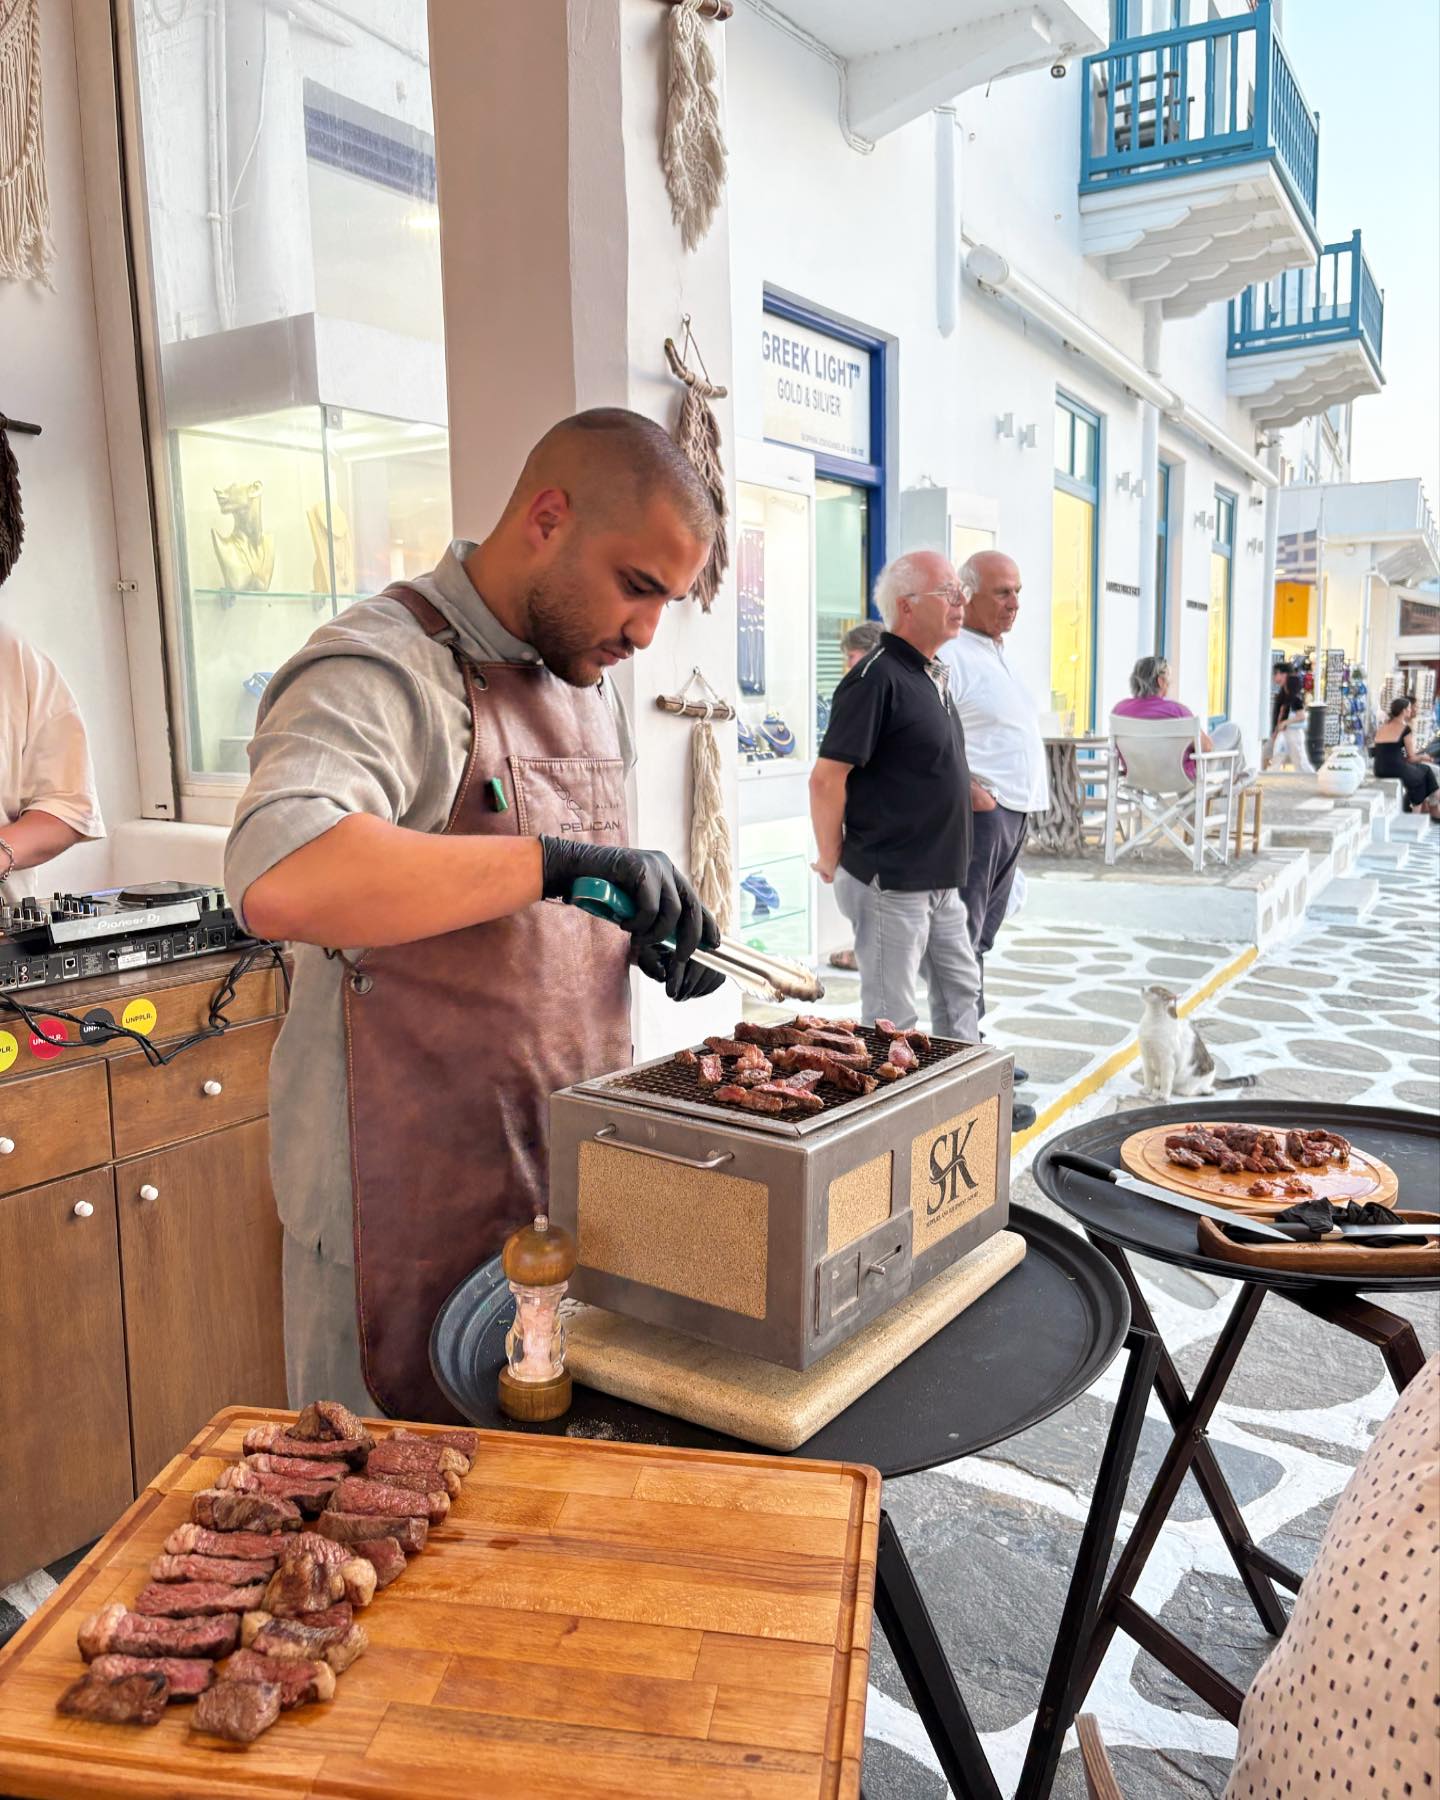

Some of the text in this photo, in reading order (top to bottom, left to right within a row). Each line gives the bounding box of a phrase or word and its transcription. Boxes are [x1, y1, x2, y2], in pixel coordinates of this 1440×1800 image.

[762, 330, 810, 375] GREEK
[777, 378, 841, 417] GOLD & SILVER
[560, 820, 621, 833] PELICAN
[97, 916, 146, 929] Pioneer
[926, 1118, 979, 1216] SK
